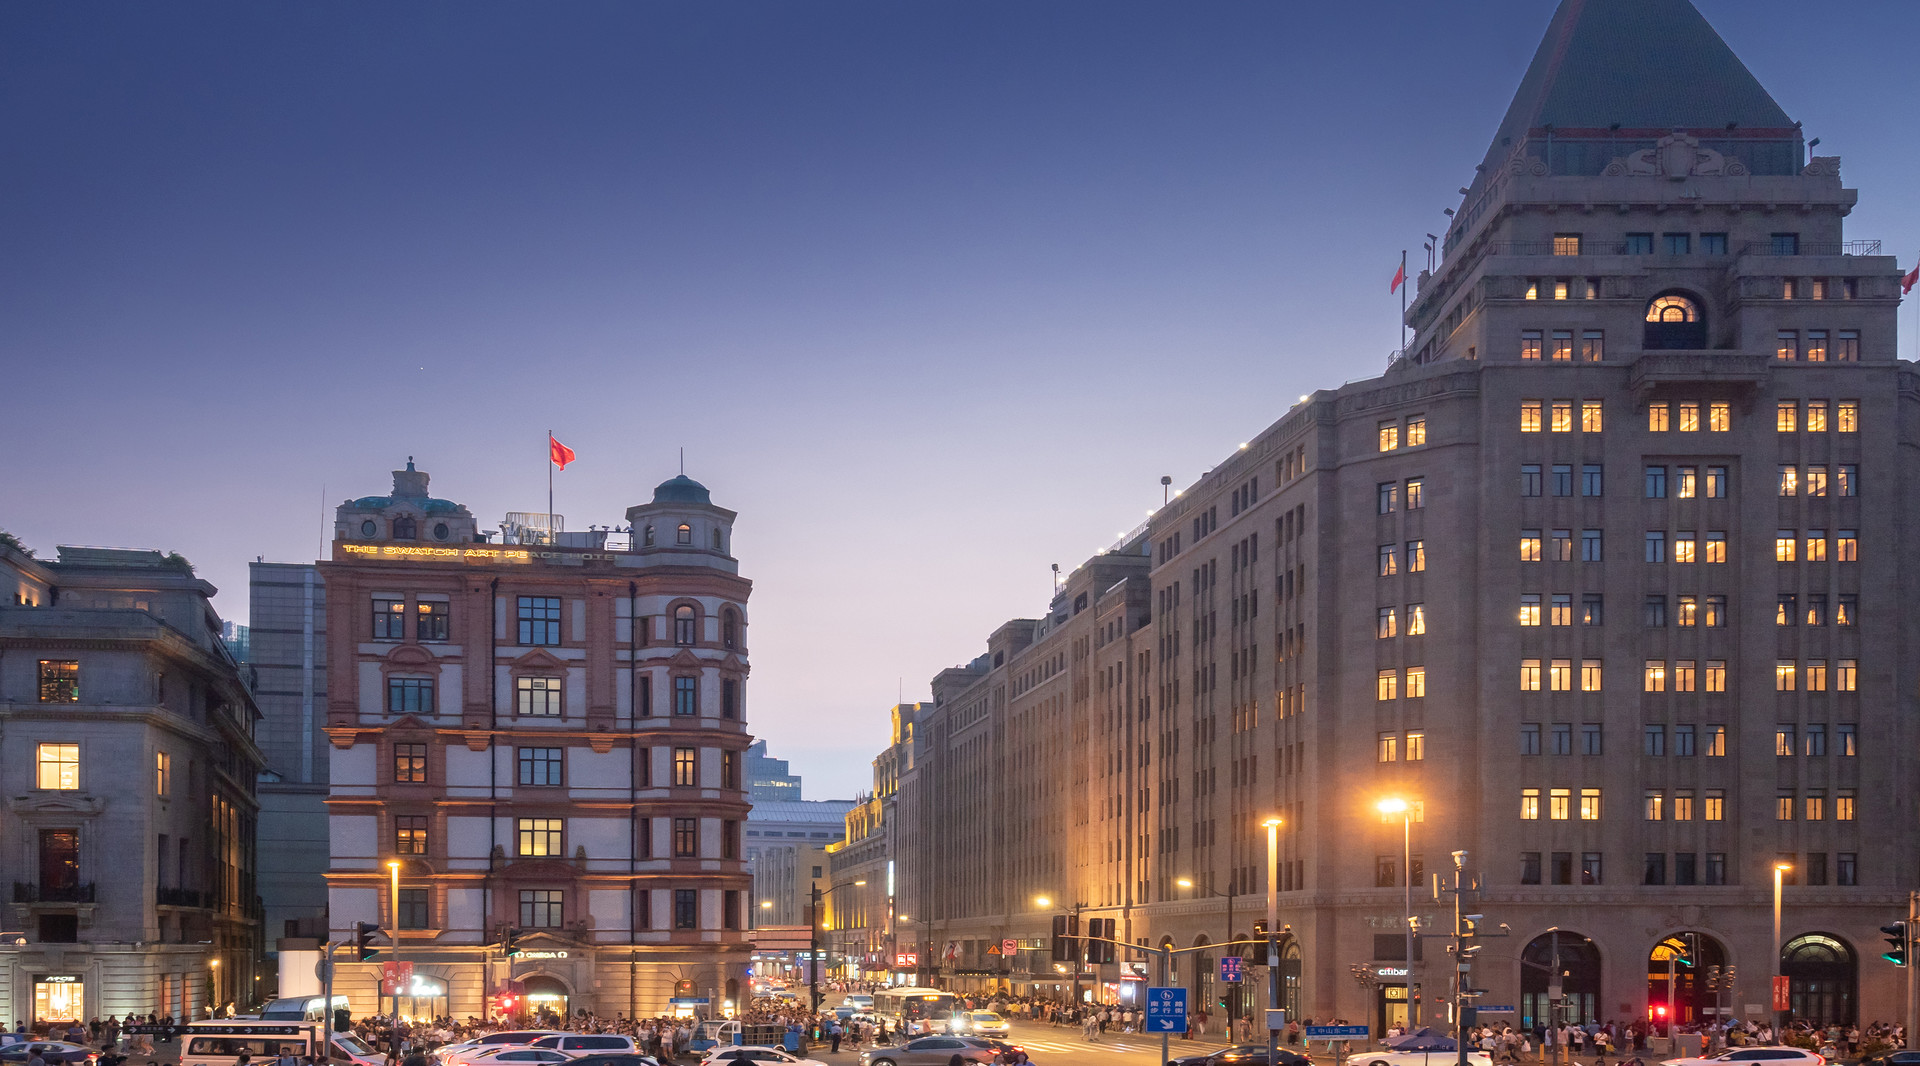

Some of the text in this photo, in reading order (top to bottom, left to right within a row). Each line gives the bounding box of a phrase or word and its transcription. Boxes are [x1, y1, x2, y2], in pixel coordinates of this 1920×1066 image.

[343, 544, 378, 554] THE
[383, 547, 458, 556] SWATCH
[464, 548, 500, 558] ART
[505, 550, 563, 560] PEACE
[526, 951, 557, 959] OMEGA
[1378, 966, 1414, 976] citiban
